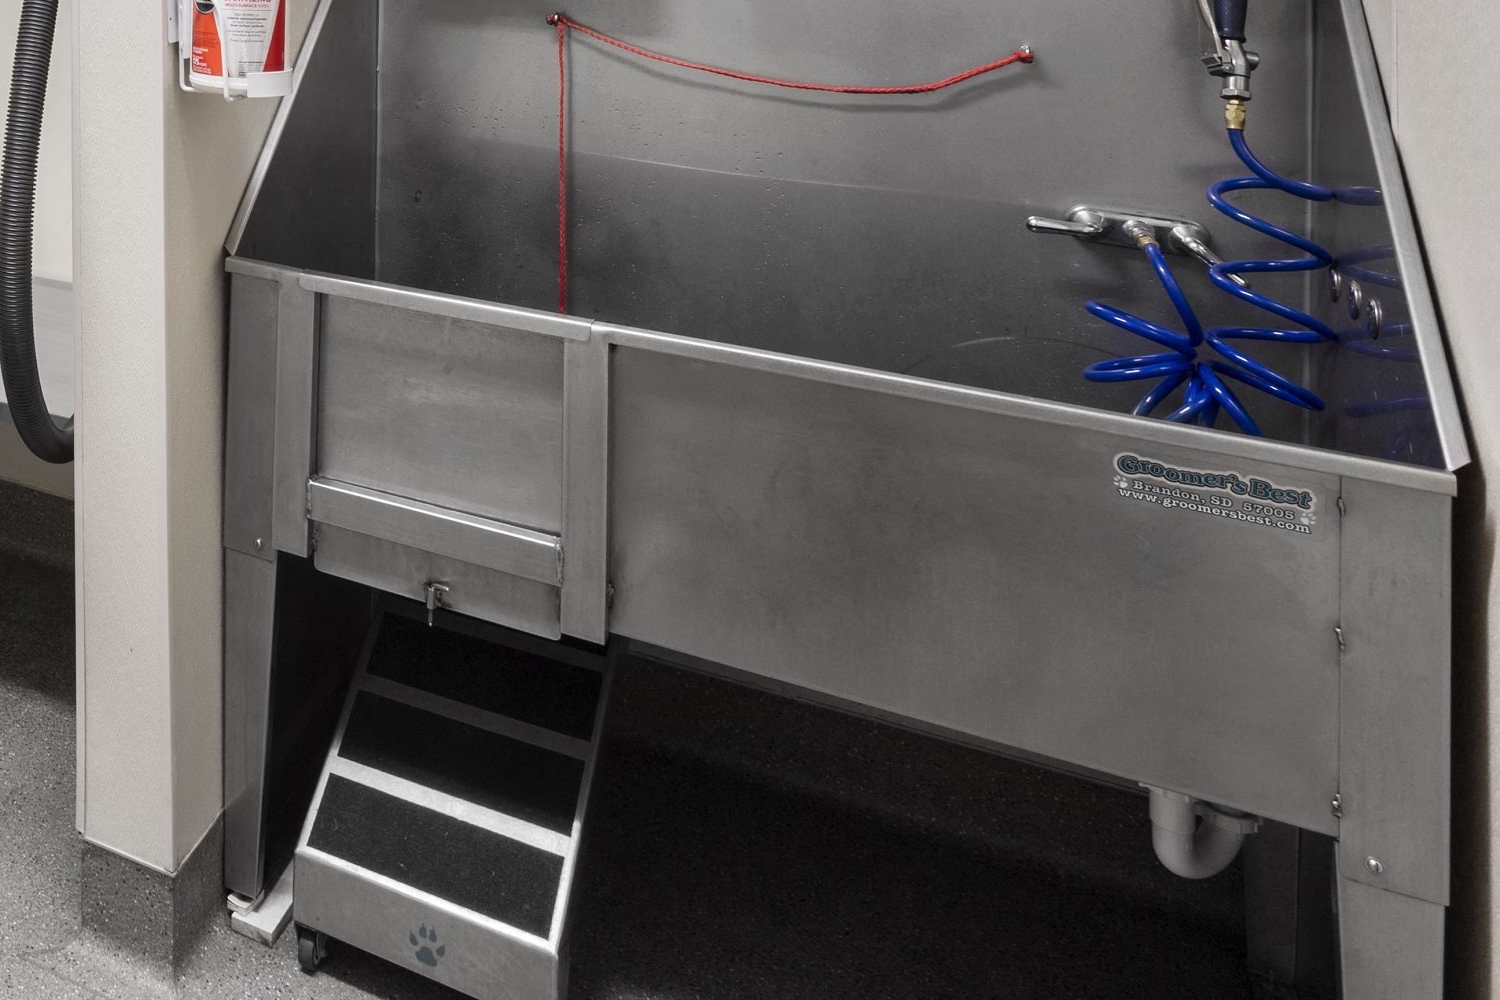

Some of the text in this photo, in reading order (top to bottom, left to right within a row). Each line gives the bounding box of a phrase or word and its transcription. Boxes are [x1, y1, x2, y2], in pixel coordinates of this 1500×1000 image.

[1117, 454, 1313, 510] Groomer's Best
[1132, 479, 1296, 521] Brandon, SD 57005
[1118, 488, 1312, 534] www.groomersbest.com
